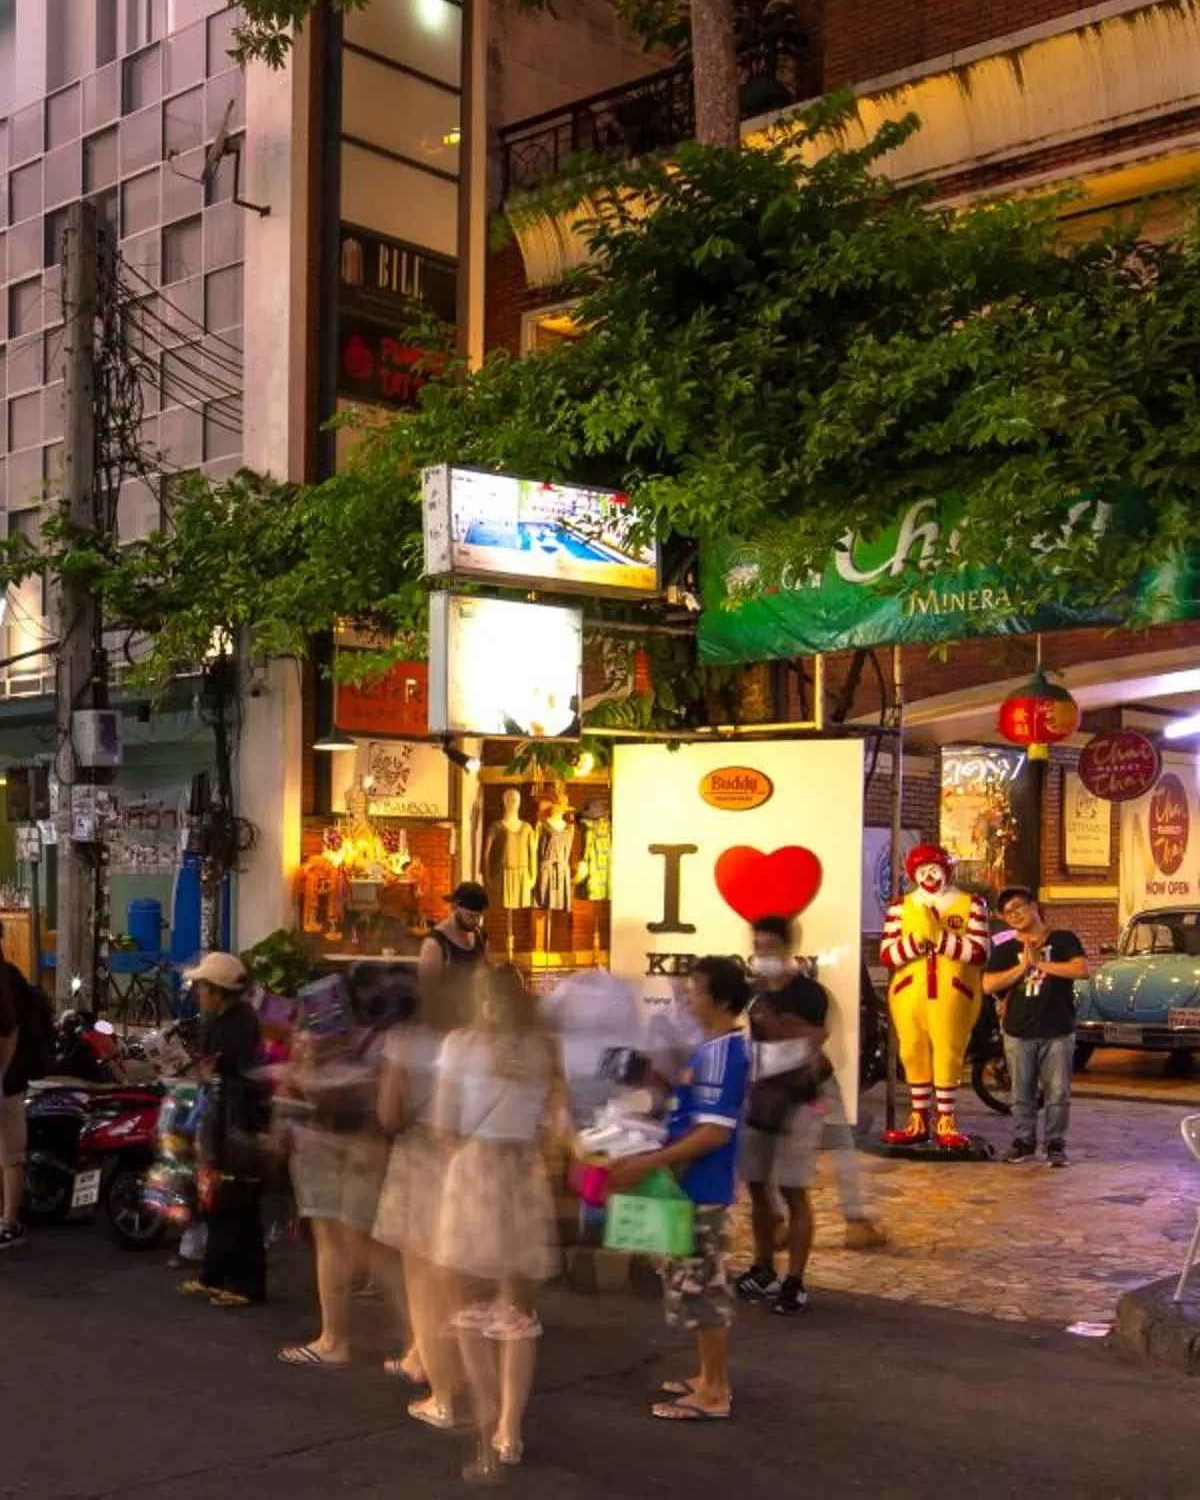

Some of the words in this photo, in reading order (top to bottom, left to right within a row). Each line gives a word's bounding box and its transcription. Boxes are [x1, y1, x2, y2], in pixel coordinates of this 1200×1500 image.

[908, 588, 1015, 617] MINERA
[711, 775, 757, 793] Buddy
[646, 843, 698, 934] I
[1146, 880, 1166, 896] NOW
[1167, 880, 1190, 896] OPEN
